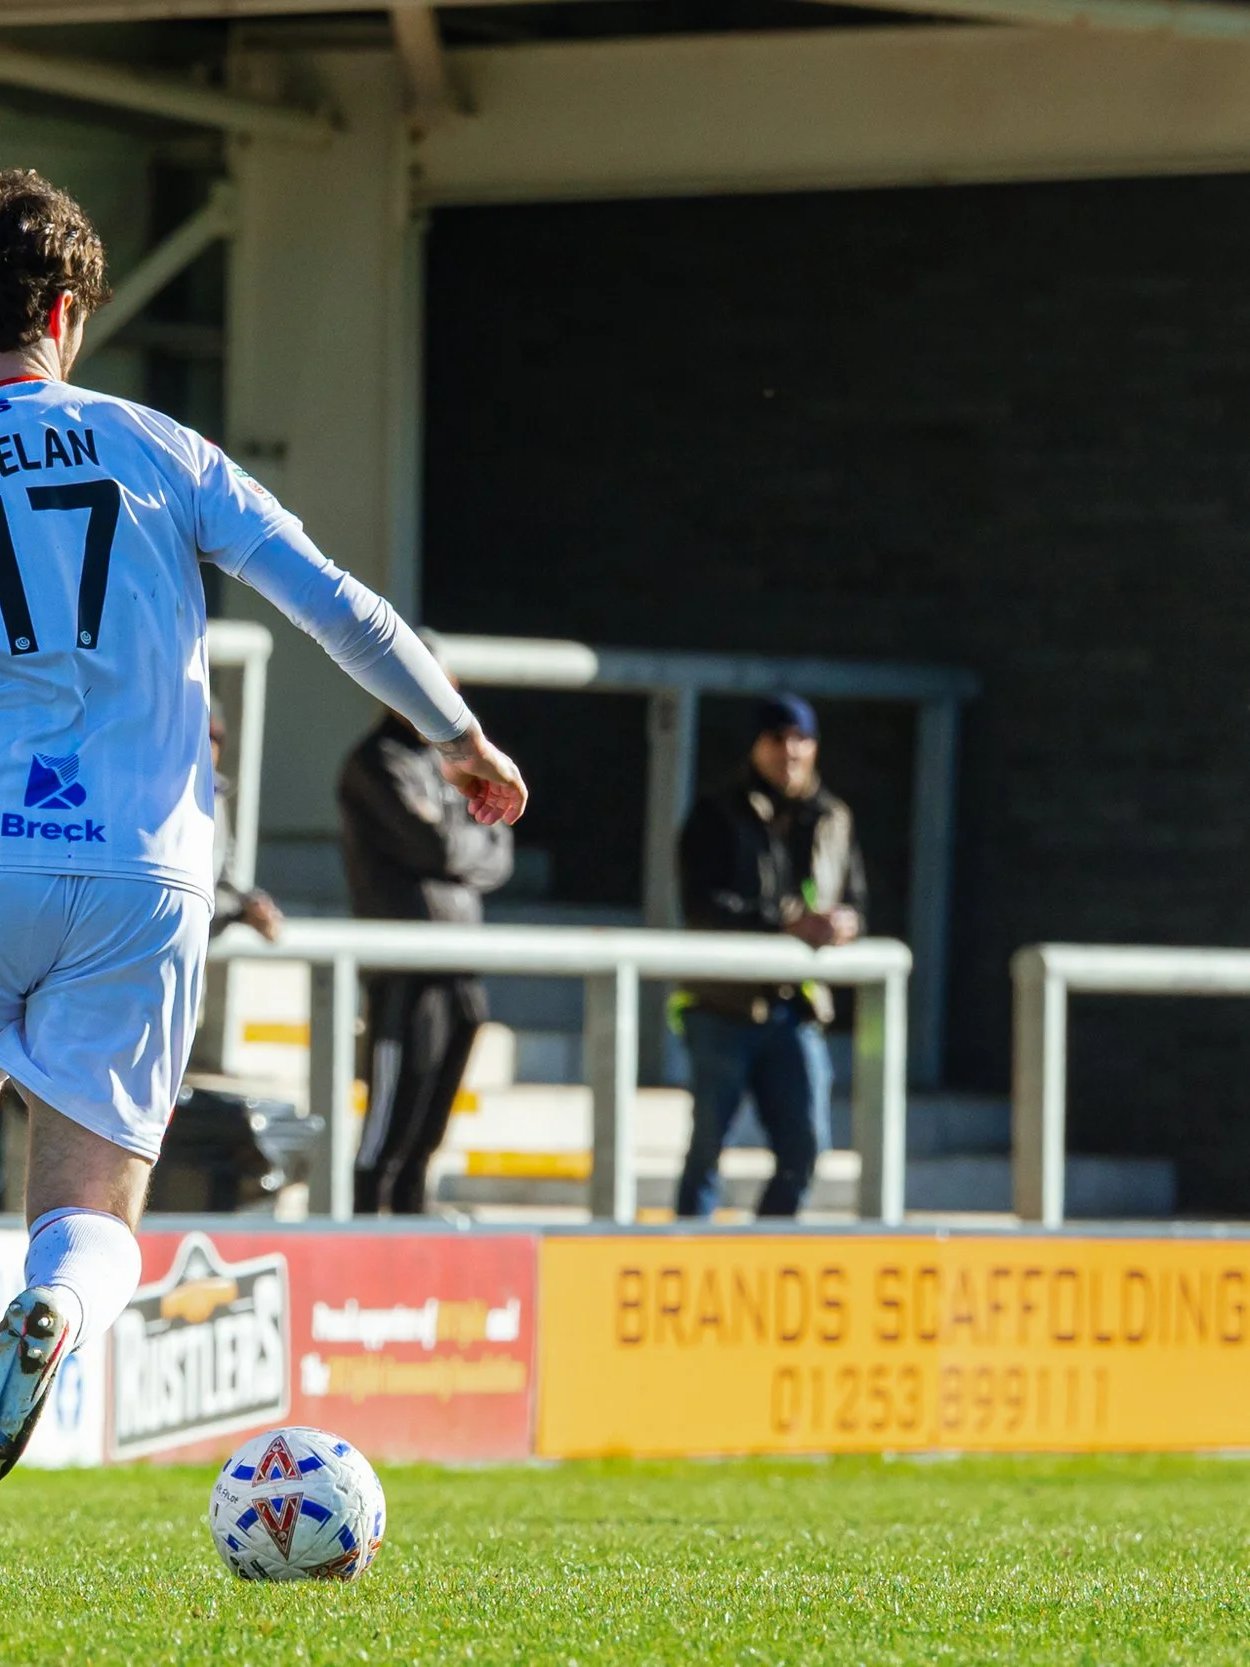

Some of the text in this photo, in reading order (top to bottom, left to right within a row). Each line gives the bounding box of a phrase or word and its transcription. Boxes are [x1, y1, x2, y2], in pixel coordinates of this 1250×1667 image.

[0, 812, 107, 842] Breck
[616, 1266, 850, 1347] BRANDS
[875, 1265, 1248, 1347] SCAFFOLDING
[770, 1363, 924, 1434] 01253
